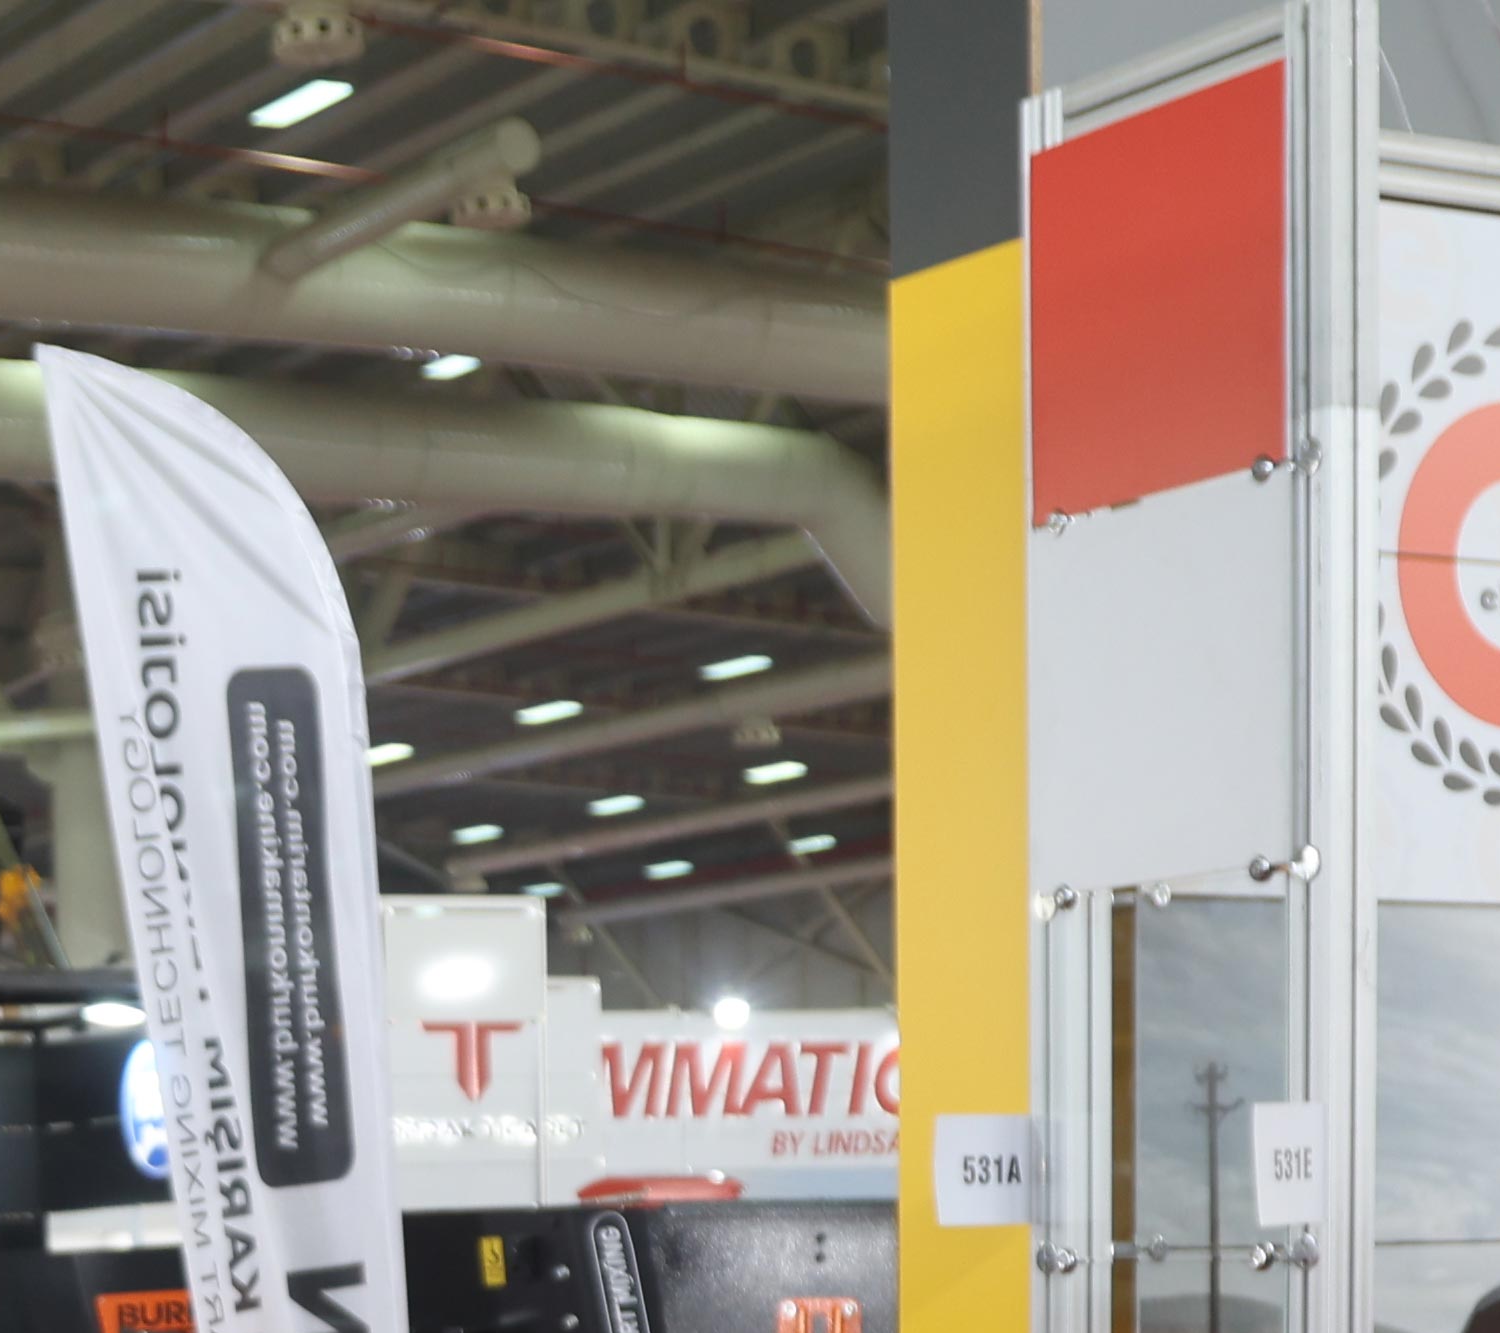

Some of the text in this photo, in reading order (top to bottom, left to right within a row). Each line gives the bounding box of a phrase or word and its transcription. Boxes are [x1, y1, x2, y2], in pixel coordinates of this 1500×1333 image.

[772, 1132, 805, 1156] BY
[962, 1154, 1023, 1186] 531A
[1274, 1148, 1315, 1182] 531E
[118, 1300, 190, 1329] BUR
